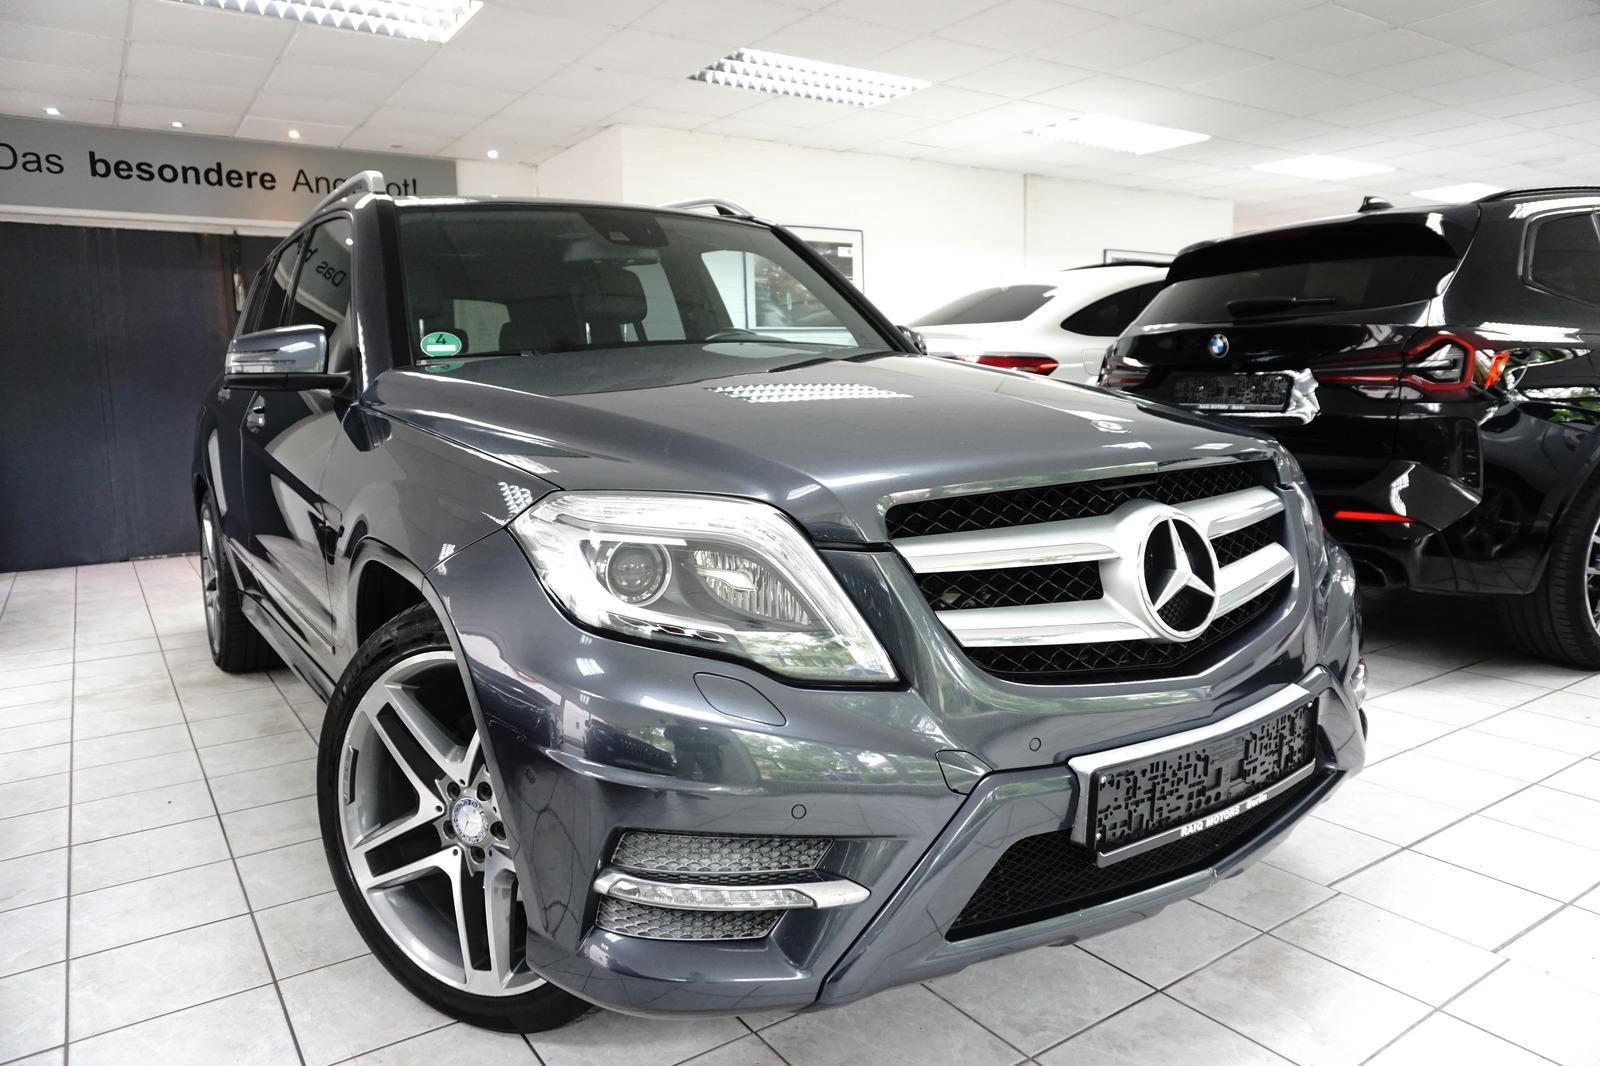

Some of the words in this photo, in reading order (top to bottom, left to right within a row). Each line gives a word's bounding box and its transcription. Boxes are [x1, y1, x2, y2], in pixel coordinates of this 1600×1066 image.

[0, 143, 64, 174] Das
[89, 151, 276, 190] besondere
[292, 169, 417, 196] Anot!
[436, 334, 447, 344] 4
[1206, 805, 1240, 828] MOTORS
